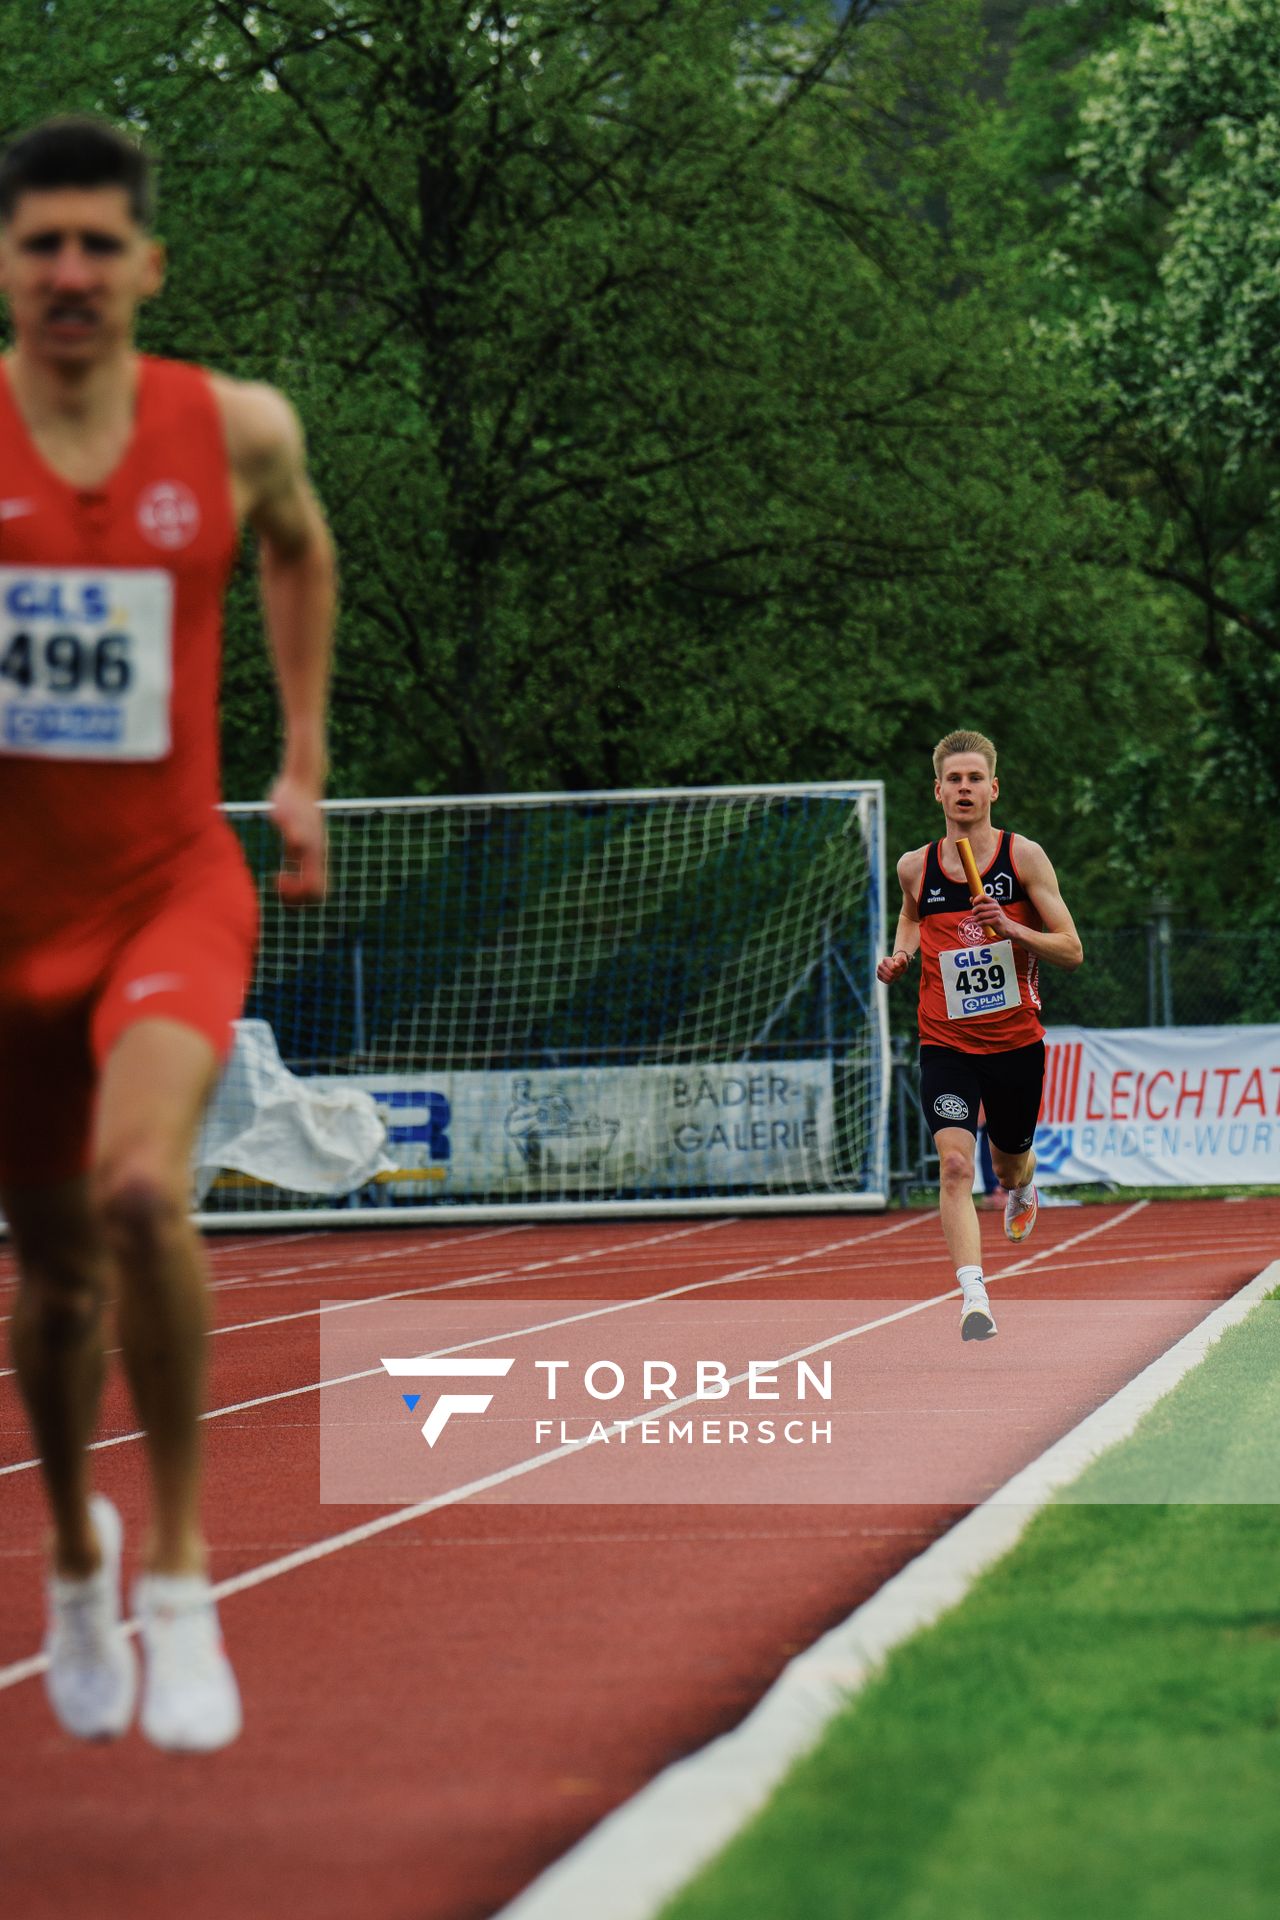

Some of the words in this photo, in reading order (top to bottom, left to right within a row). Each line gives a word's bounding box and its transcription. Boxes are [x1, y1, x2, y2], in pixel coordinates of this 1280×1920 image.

[0, 631, 133, 695] 496
[955, 965, 1006, 995] 439
[980, 994, 1004, 1006] PLAN
[1081, 1121, 1280, 1157] BADEN-WÜR
